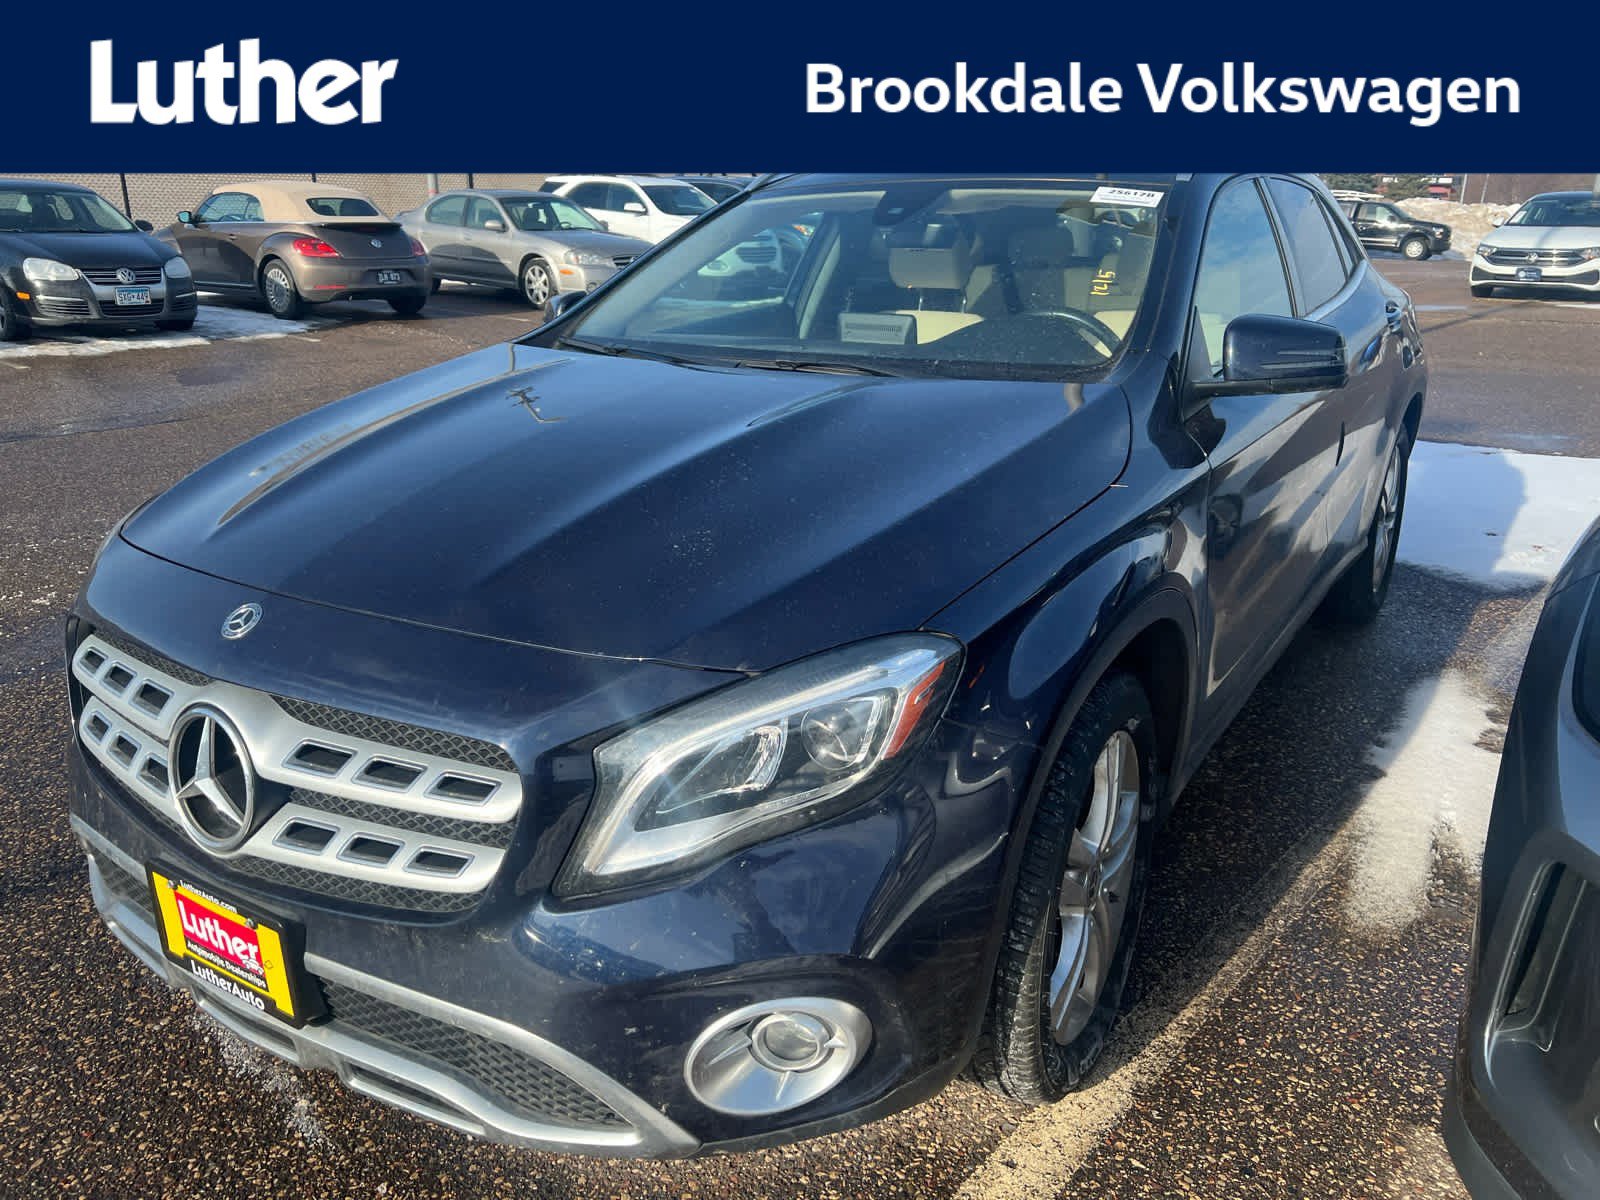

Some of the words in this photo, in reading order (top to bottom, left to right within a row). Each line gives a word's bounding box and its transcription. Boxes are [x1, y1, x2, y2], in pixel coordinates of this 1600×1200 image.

[180, 880, 238, 914] LutherAuto.com
[177, 899, 258, 960] Luther
[190, 959, 265, 1010] LutherAuto
